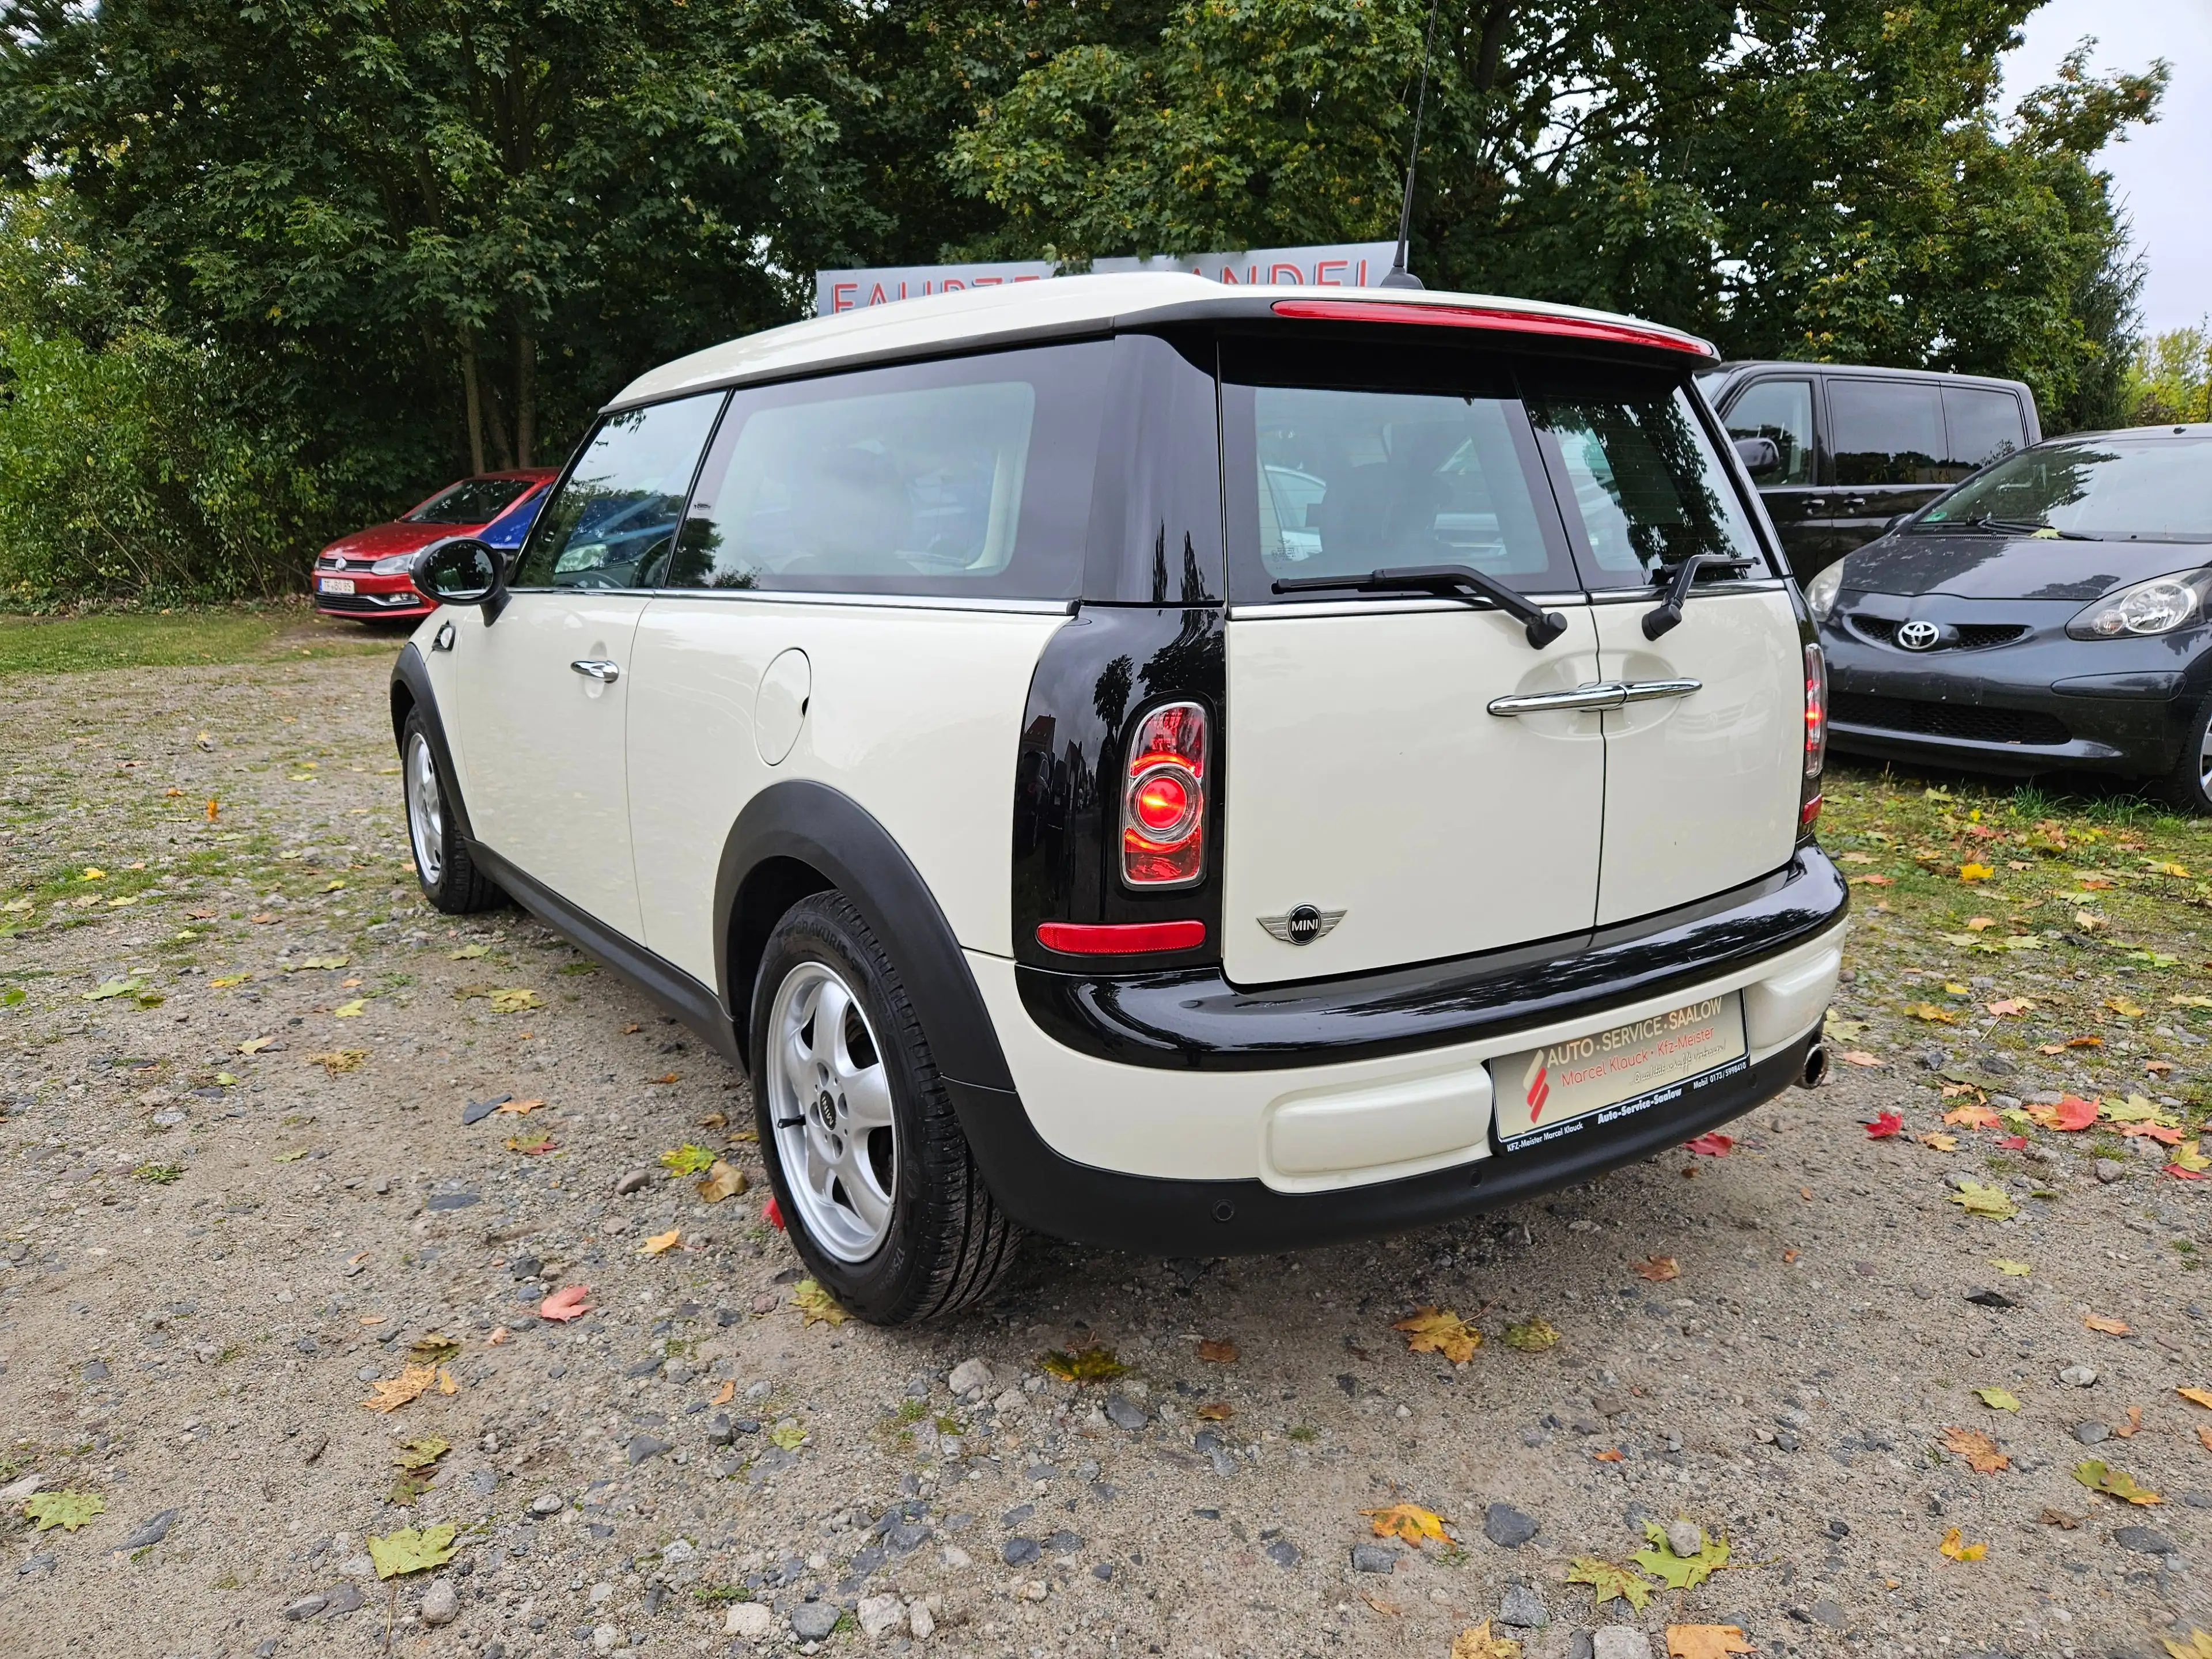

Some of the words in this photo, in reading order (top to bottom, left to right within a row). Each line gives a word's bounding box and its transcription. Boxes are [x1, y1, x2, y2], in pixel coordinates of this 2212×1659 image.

[1291, 919, 1319, 931] MINI
[1547, 1038, 1594, 1069] AUTO
[1602, 1016, 1663, 1051] SERVICE
[1669, 997, 1722, 1031] SAALOW
[1561, 1059, 1607, 1088] Marcel
[1609, 1049, 1649, 1073] Klauck
[1657, 1027, 1715, 1056] Kfz-Meister
[821, 1096, 834, 1126] MINI
[1507, 1135, 1543, 1152] KFZ-Meister
[1543, 1130, 1563, 1141] Marcel
[1564, 1121, 1584, 1135] Klauck
[1597, 1088, 1682, 1124] Auto-Service-Saalow
[1694, 1076, 1709, 1090] Mobil
